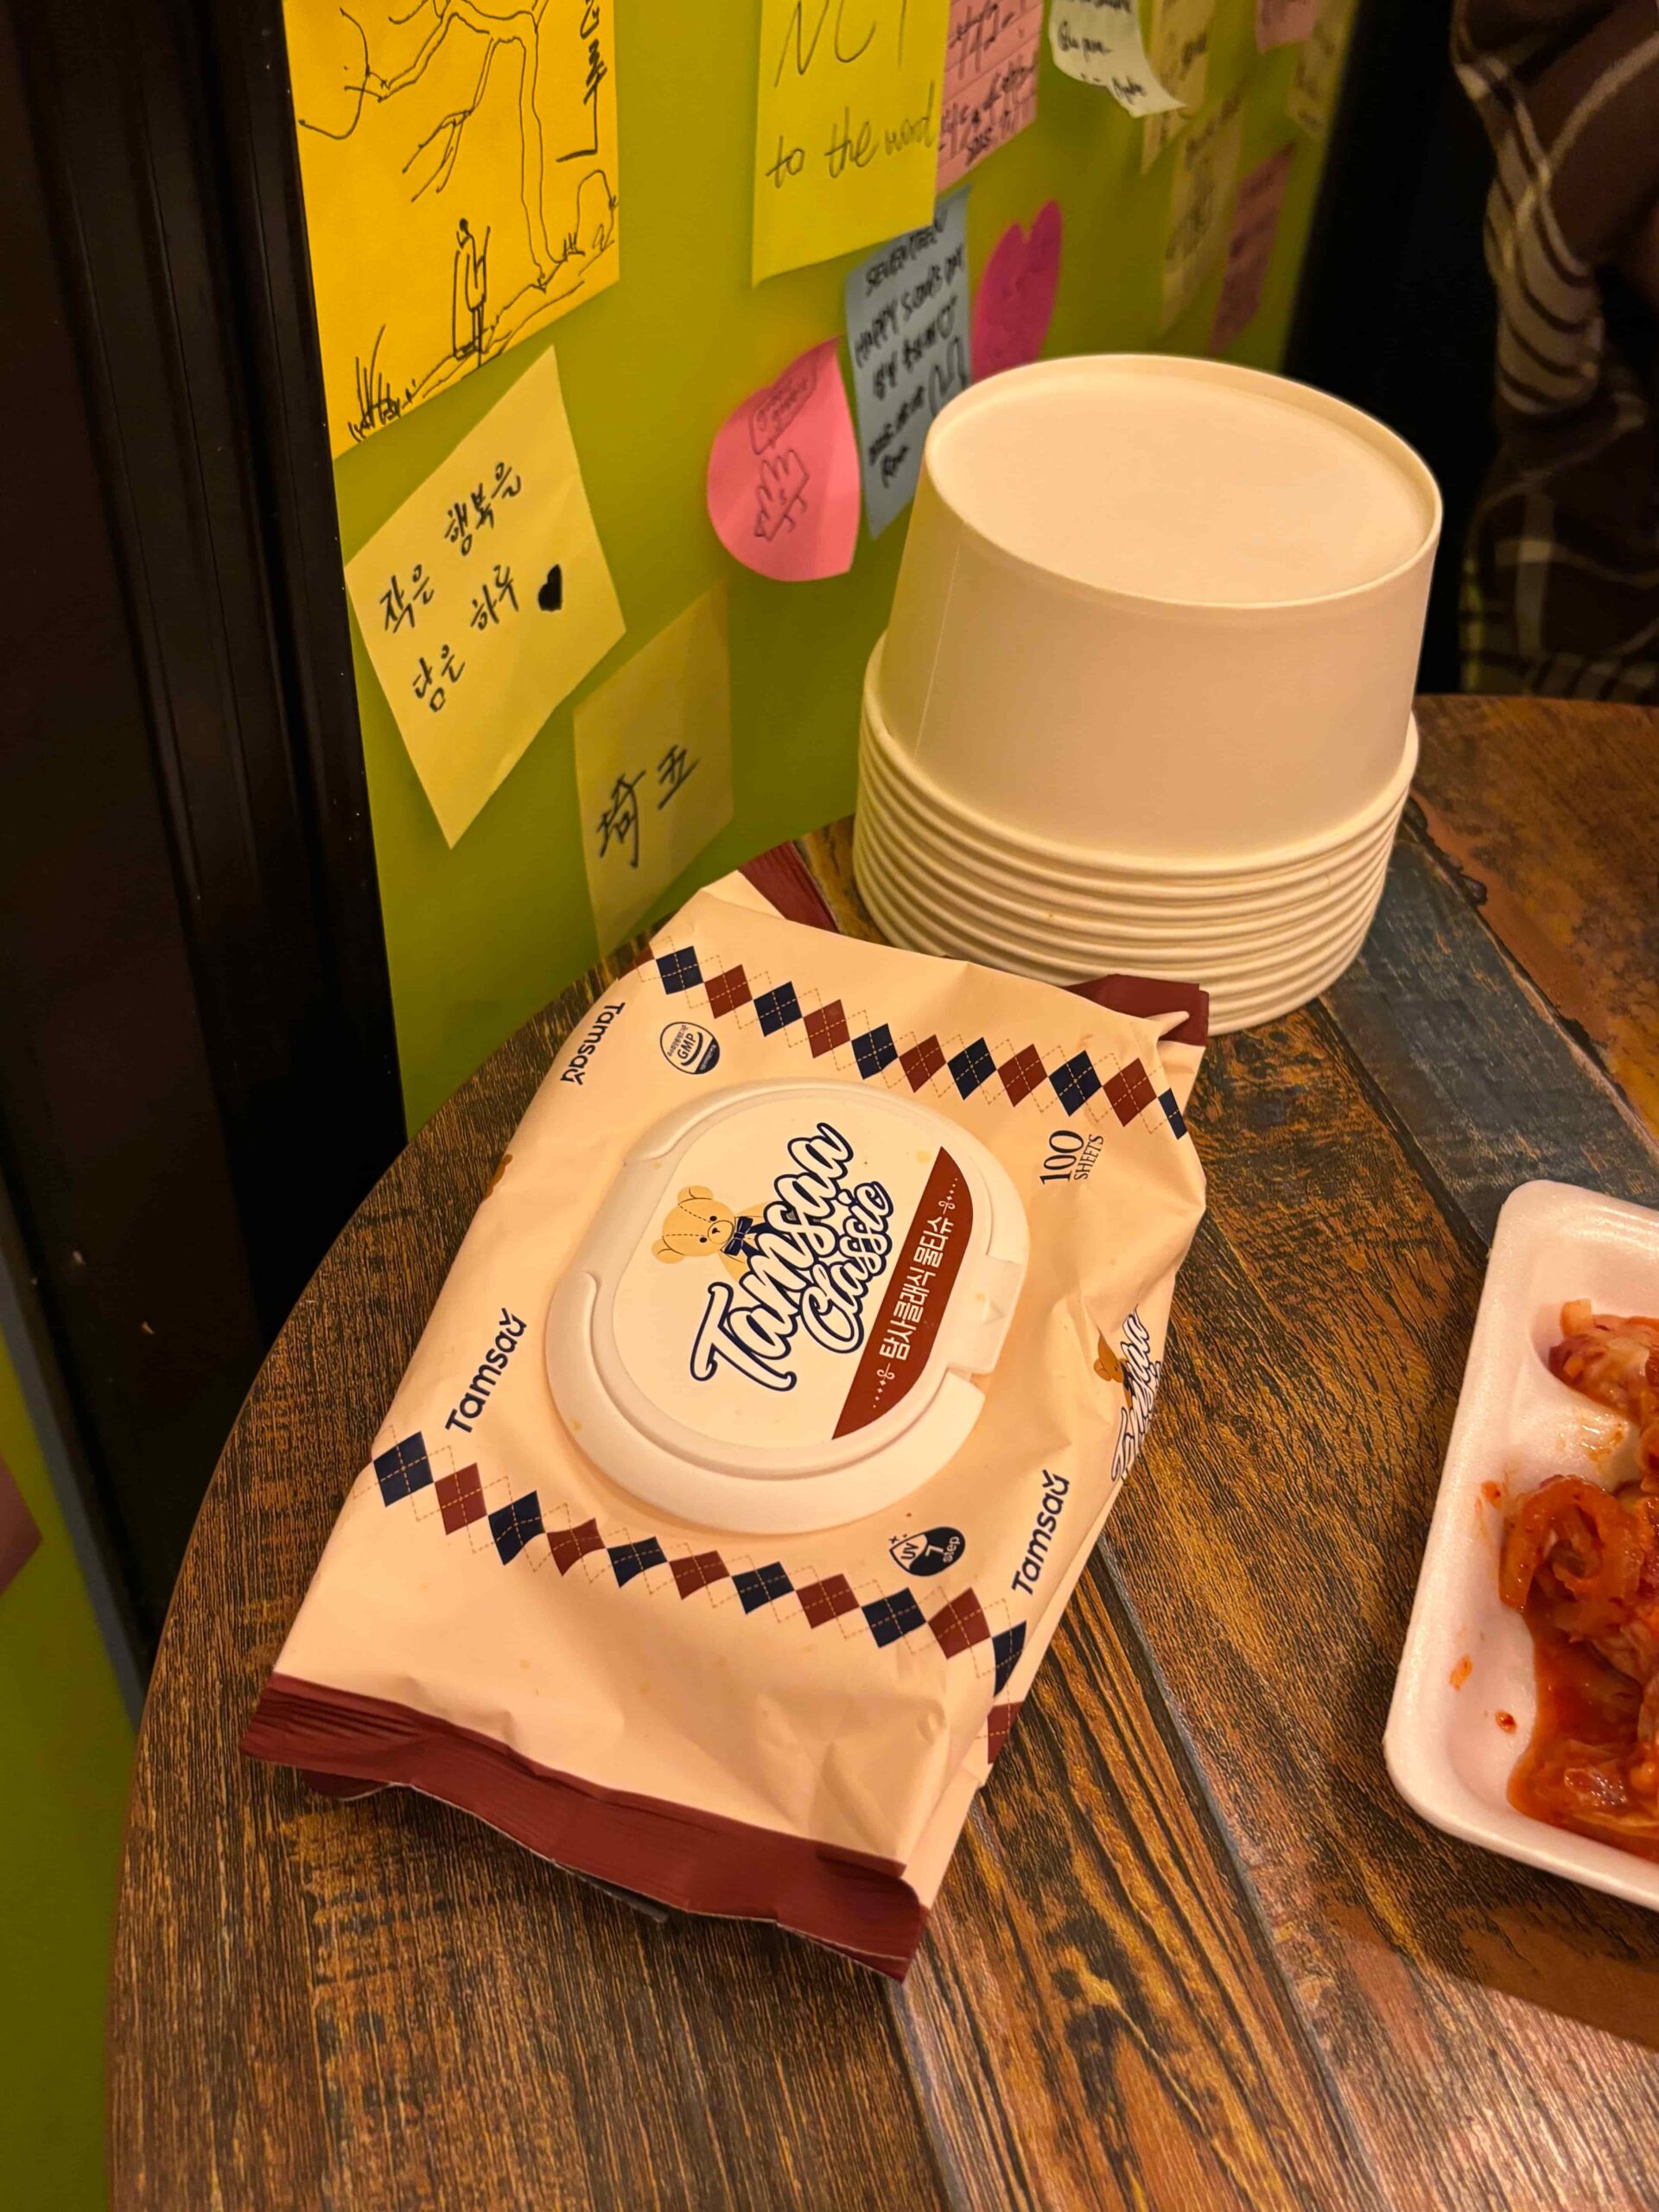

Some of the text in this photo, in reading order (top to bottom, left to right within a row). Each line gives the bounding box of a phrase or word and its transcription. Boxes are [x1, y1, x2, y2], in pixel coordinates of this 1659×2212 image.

[766, 135, 804, 188] to
[823, 105, 880, 179] the
[855, 297, 899, 369] HAPPY
[379, 563, 435, 634] 작은
[412, 564, 519, 713] 담은 하루
[677, 1033, 696, 1060] GMP
[1039, 1129, 1084, 1185] 100
[1072, 1133, 1104, 1181] SHEETS
[690, 1122, 855, 1392] Tamsaa
[798, 1180, 894, 1354] Classic
[879, 1216, 955, 1361] 탐사클래식 물티슈
[900, 1542, 919, 1560] UV
[943, 1535, 961, 1563] step
